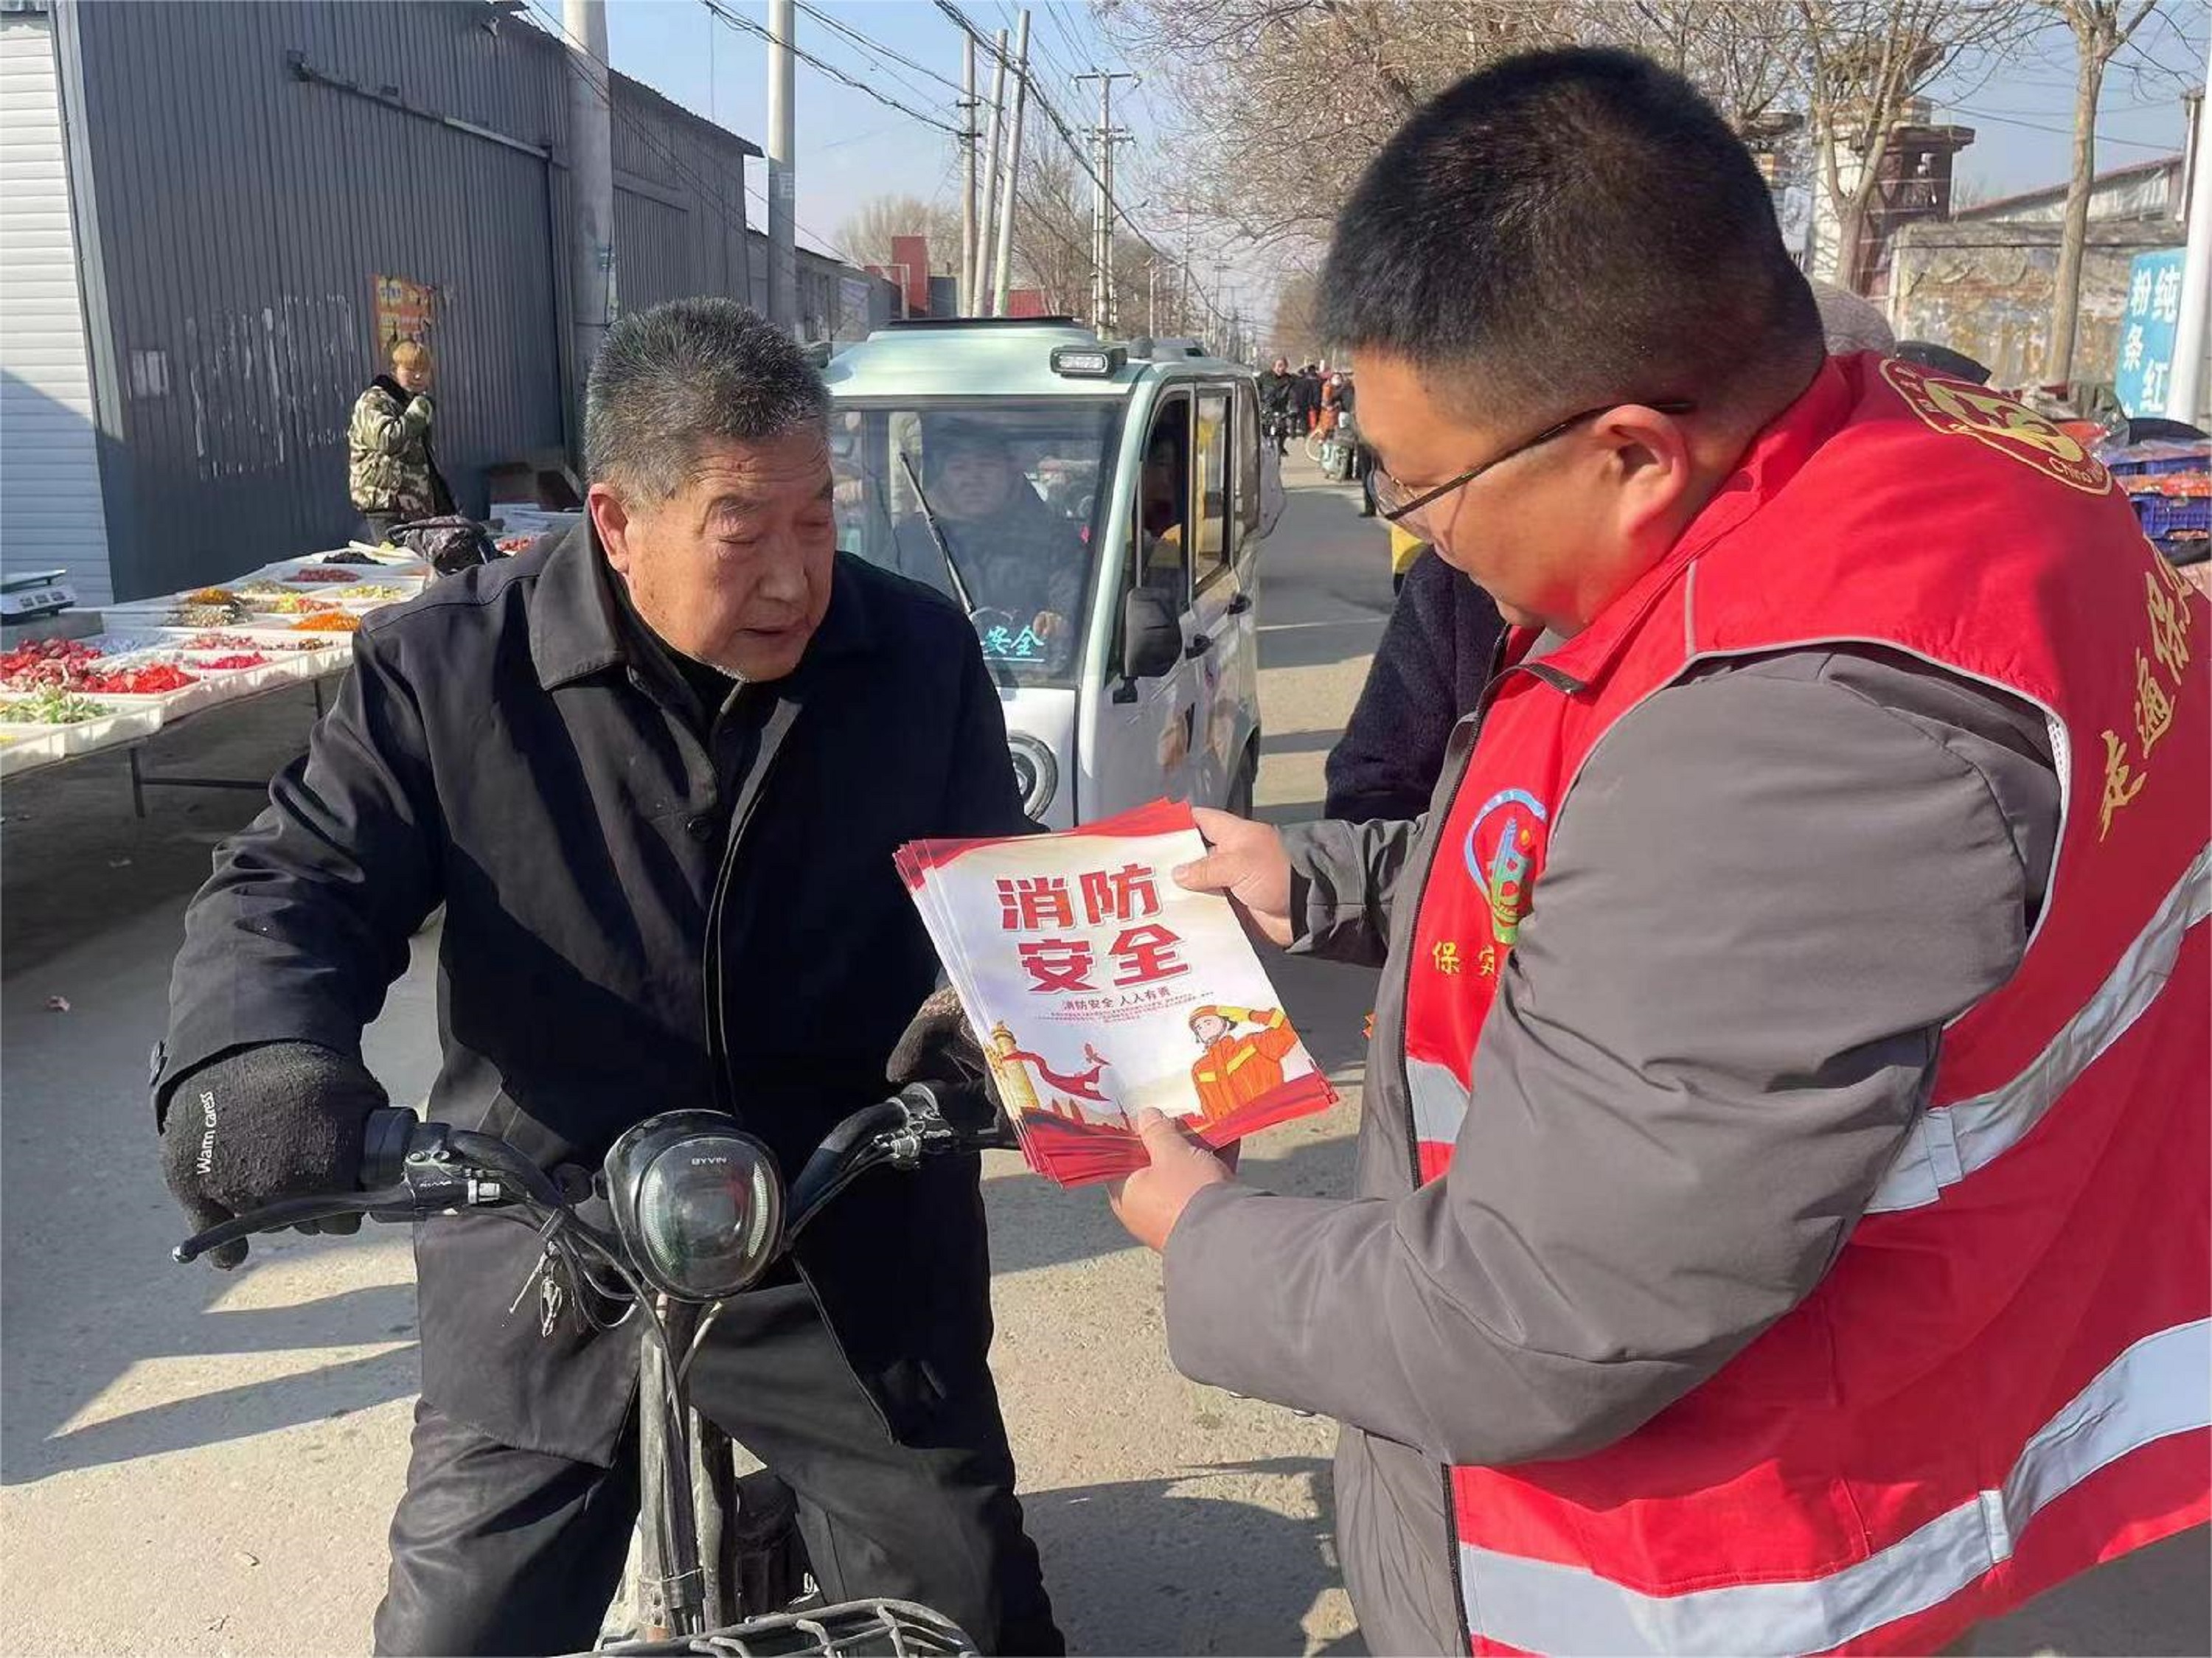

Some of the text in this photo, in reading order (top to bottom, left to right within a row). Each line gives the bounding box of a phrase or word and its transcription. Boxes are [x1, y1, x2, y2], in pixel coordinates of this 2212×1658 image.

[981, 625, 1045, 656] 安全
[995, 863, 1161, 930] 消防
[1018, 923, 1189, 992] 安全
